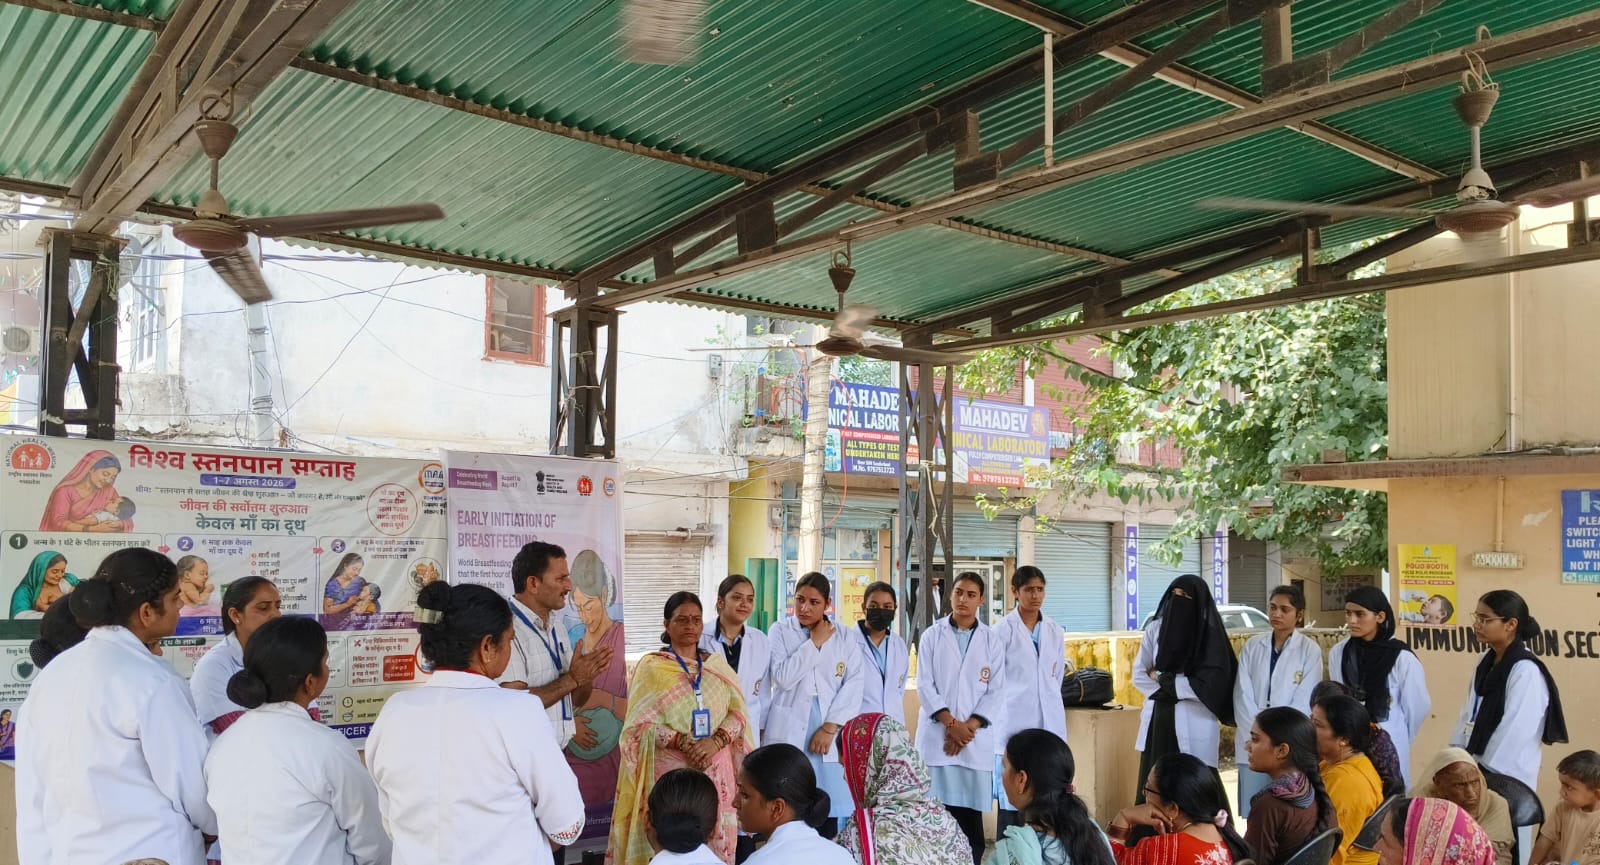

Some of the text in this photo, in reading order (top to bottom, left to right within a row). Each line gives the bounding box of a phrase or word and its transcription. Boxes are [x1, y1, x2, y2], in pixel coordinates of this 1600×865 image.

[835, 386, 900, 411] MAHADE
[828, 408, 900, 432] NICAL LABOR
[960, 406, 1028, 433] MAHADEV
[847, 440, 857, 448] ALL
[859, 441, 876, 449] TYPES
[878, 442, 886, 450] OF
[952, 431, 984, 450] INICAL
[986, 436, 1047, 457] LABORATORY
[128, 444, 356, 481] विश्व स्तनपान सप्ताह
[233, 477, 259, 487] अगस्त
[179, 498, 308, 516] जीवन की सर्वोत्तम शुरुआत
[195, 513, 306, 535] केवल माँ का दूध
[457, 510, 556, 528] EARLY INITIATION OF
[1566, 527, 1600, 537] SWITC
[1566, 539, 1596, 548] LIGHT
[458, 559, 511, 568] World Breastfeeding
[1583, 550, 1600, 559] WH
[458, 570, 511, 578] that the first hour of
[1570, 561, 1590, 571] NOT
[1127, 531, 1137, 631] APOL
[1405, 625, 1600, 659] IMMUNION SEC
